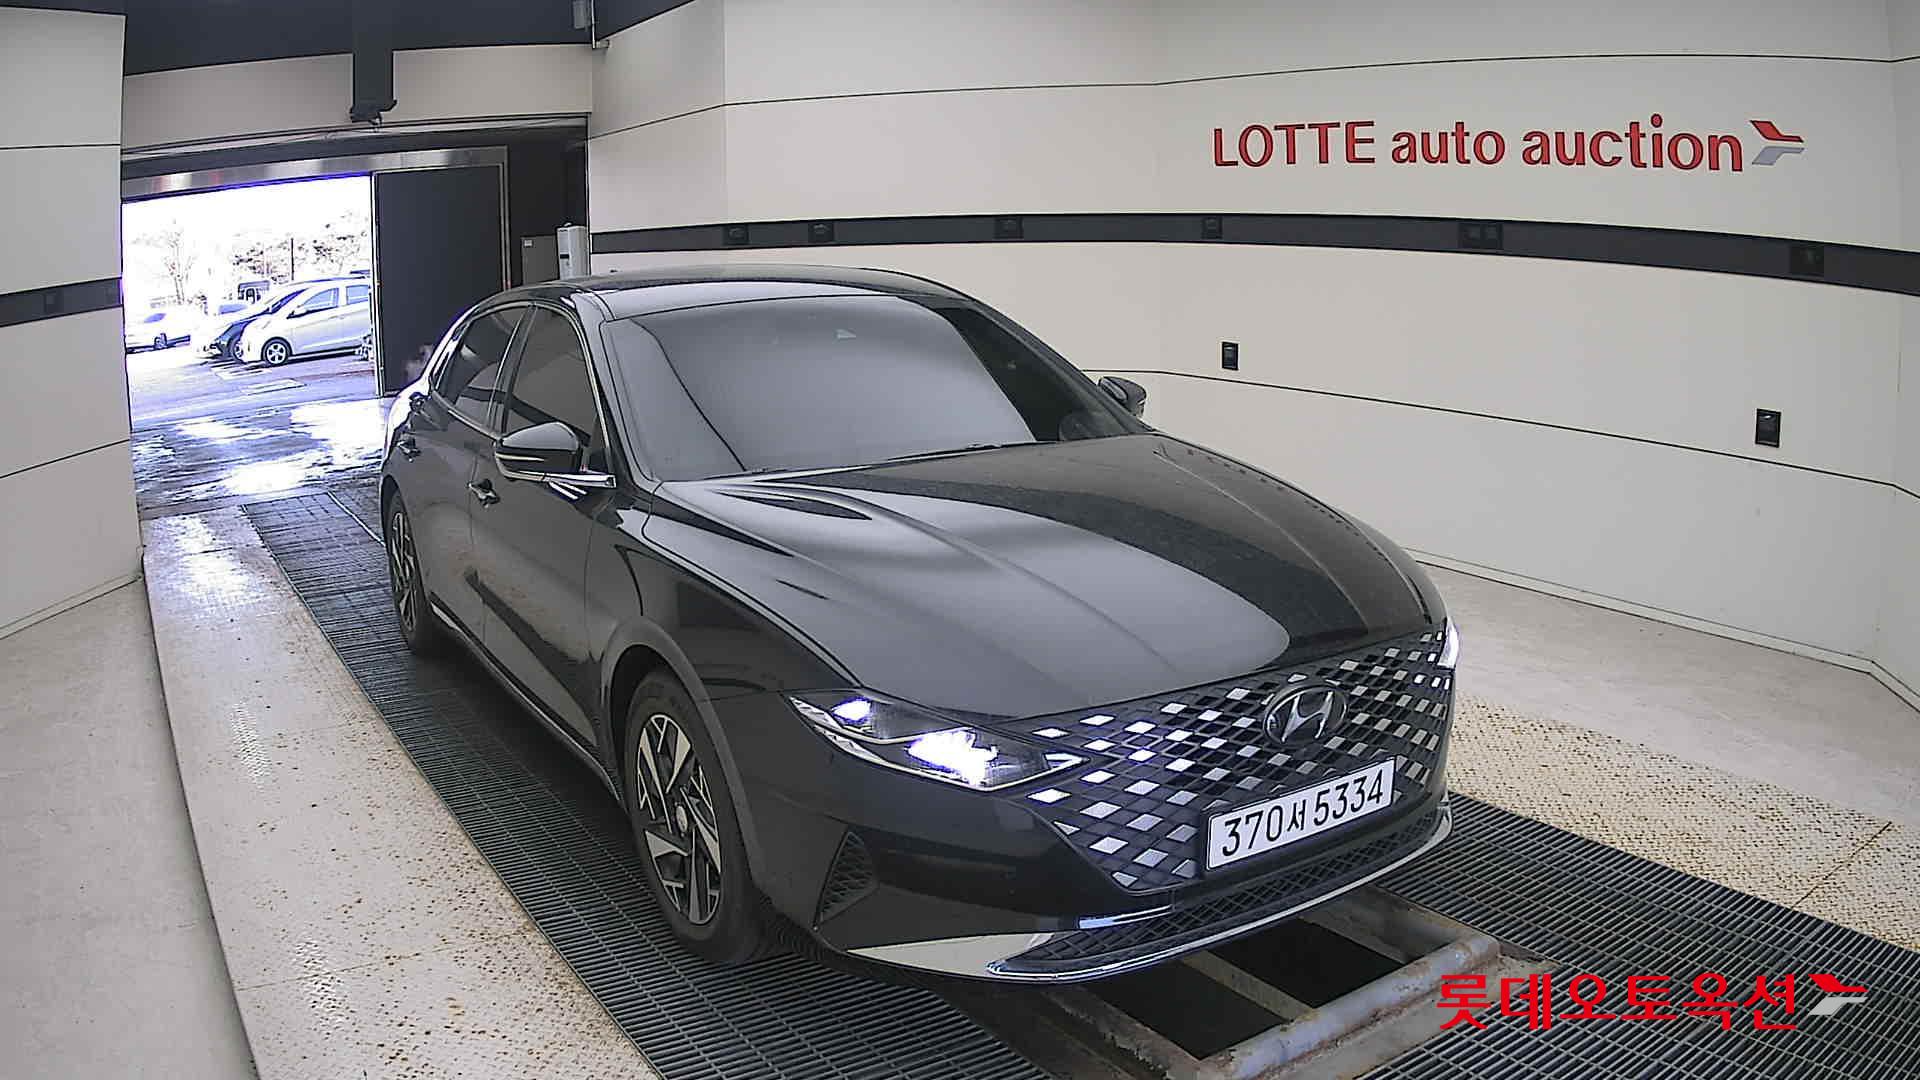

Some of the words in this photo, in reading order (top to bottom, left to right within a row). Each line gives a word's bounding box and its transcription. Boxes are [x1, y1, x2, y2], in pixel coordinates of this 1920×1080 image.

[1212, 120, 1376, 168] LOTTE
[1391, 121, 1506, 167] auto
[1521, 113, 1744, 173] auction
[1313, 768, 1384, 827] 5334
